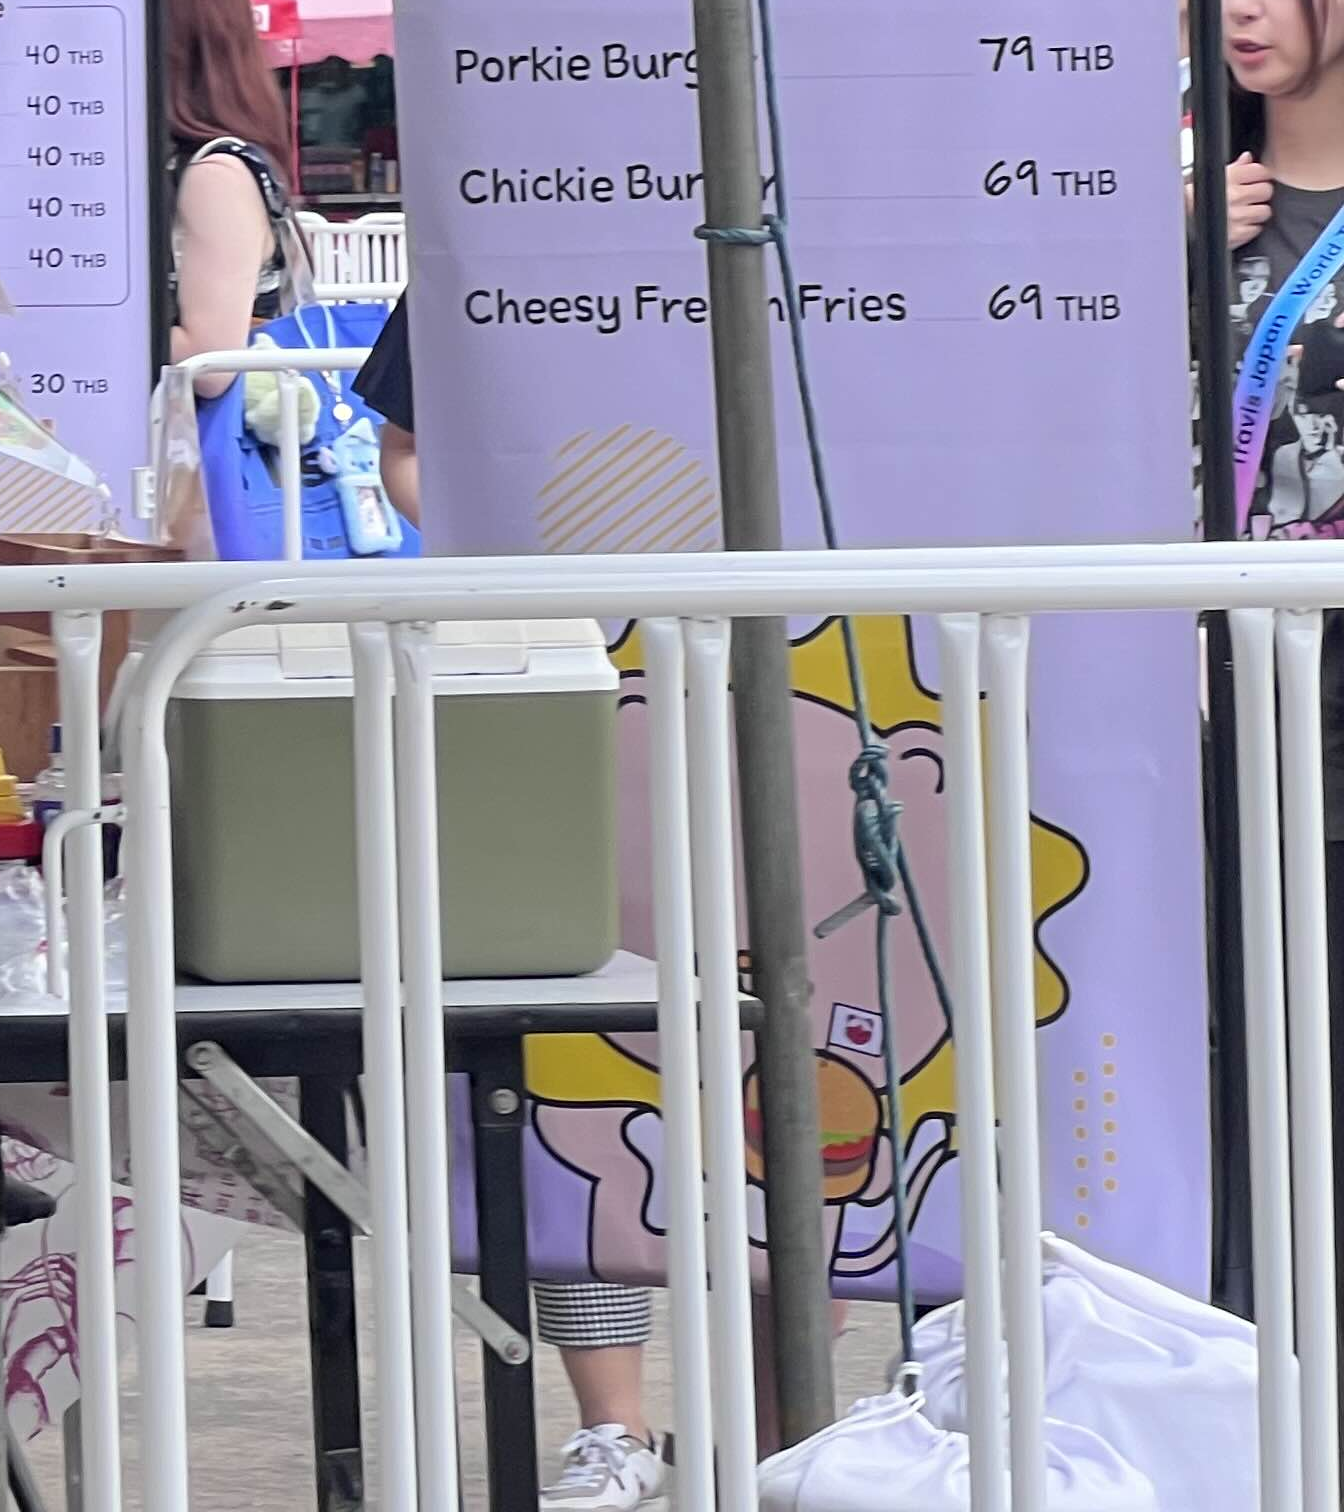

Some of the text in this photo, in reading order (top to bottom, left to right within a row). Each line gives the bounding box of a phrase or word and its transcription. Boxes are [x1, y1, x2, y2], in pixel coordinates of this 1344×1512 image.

[25, 44, 60, 65] 40
[68, 50, 104, 65] THB
[455, 45, 592, 85] Porkie
[979, 35, 1034, 73] 79
[1047, 45, 1115, 73] THB
[26, 95, 62, 116] 40
[68, 101, 104, 117] THB
[27, 146, 62, 167] 40
[69, 152, 106, 167] THB
[459, 166, 615, 204] Chickie
[984, 159, 1039, 197] 69
[1051, 169, 1118, 197] THB
[27, 197, 63, 218] 40
[70, 203, 107, 218] THB
[28, 248, 64, 269] 40
[70, 254, 108, 269] THB
[464, 287, 622, 334] Cheesy
[797, 284, 909, 323] Fries
[988, 284, 1043, 321] 69
[1055, 294, 1121, 322] THB
[1250, 314, 1288, 389] Japan
[1290, 242, 1343, 296] World
[30, 374, 65, 394] 30
[72, 379, 110, 395] THB
